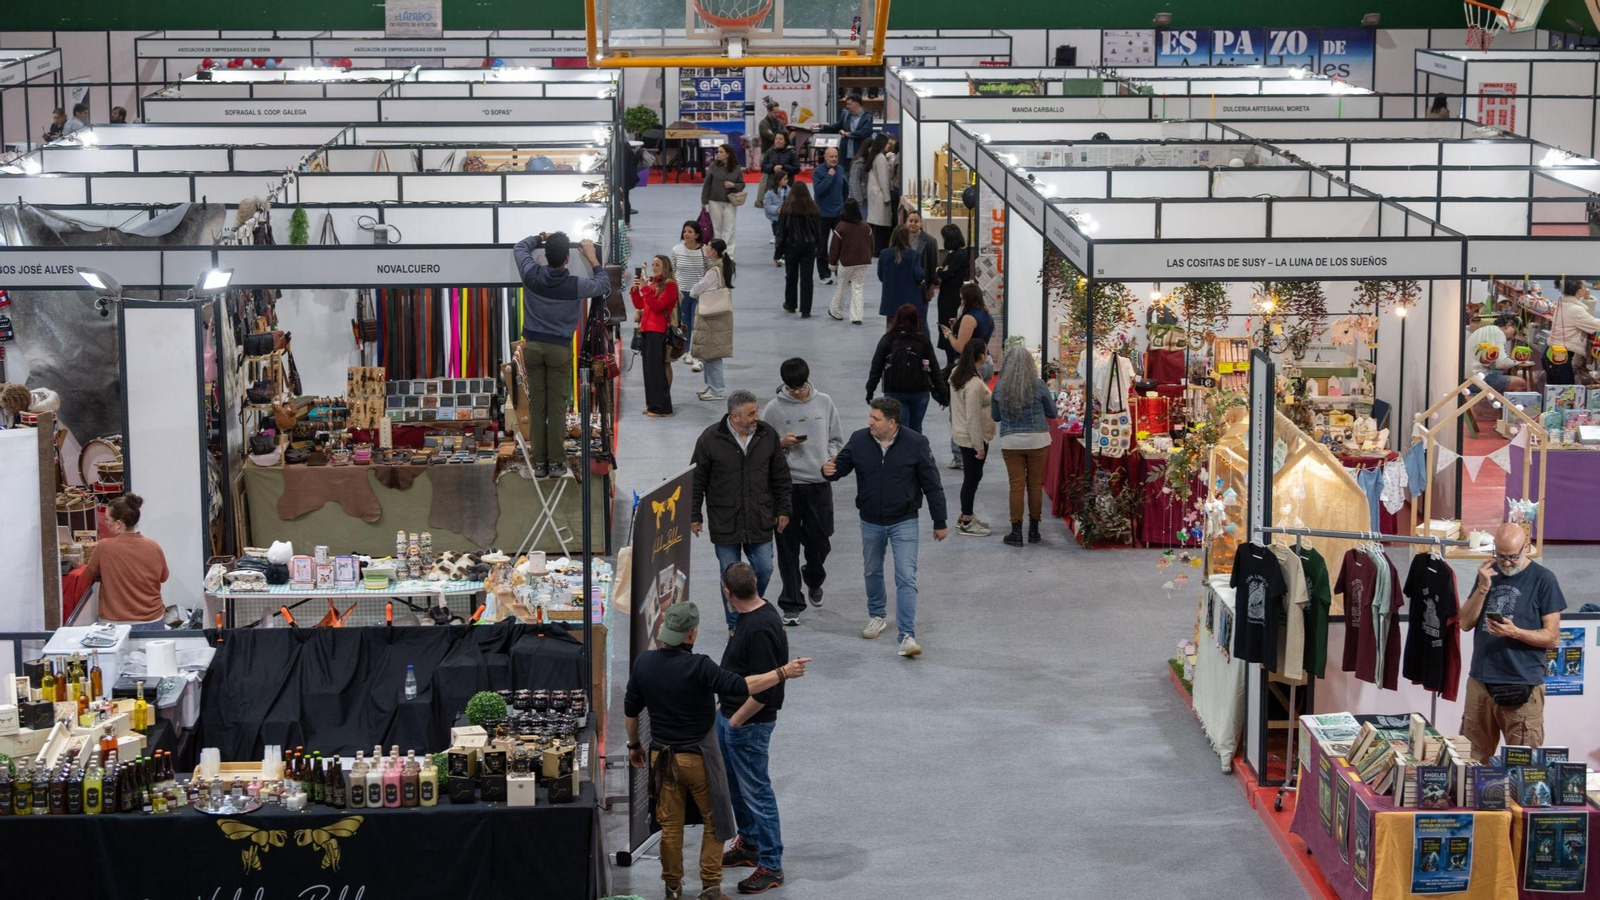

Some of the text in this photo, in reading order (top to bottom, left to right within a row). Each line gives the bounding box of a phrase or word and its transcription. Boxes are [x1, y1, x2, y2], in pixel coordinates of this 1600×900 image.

[1160, 30, 1198, 55] ES
[1213, 30, 1254, 55] PA
[1269, 30, 1308, 55] ZO
[1322, 40, 1346, 55] DE
[1166, 258, 1185, 268] LAS
[1187, 258, 1226, 268] COSITAS
[1228, 258, 1240, 267] DE
[1242, 258, 1267, 267] SUSY
[1275, 258, 1288, 267] LA
[1289, 258, 1314, 267] LUNA
[1316, 258, 1328, 266] DE
[1330, 257, 1349, 266] LOS
[1350, 256, 1388, 266] SUEÑOS
[18, 263, 43, 275] JOSÉ
[45, 265, 75, 275] ALVES
[377, 264, 441, 274] NOVALCUERO
[1256, 504, 1261, 520] LA
